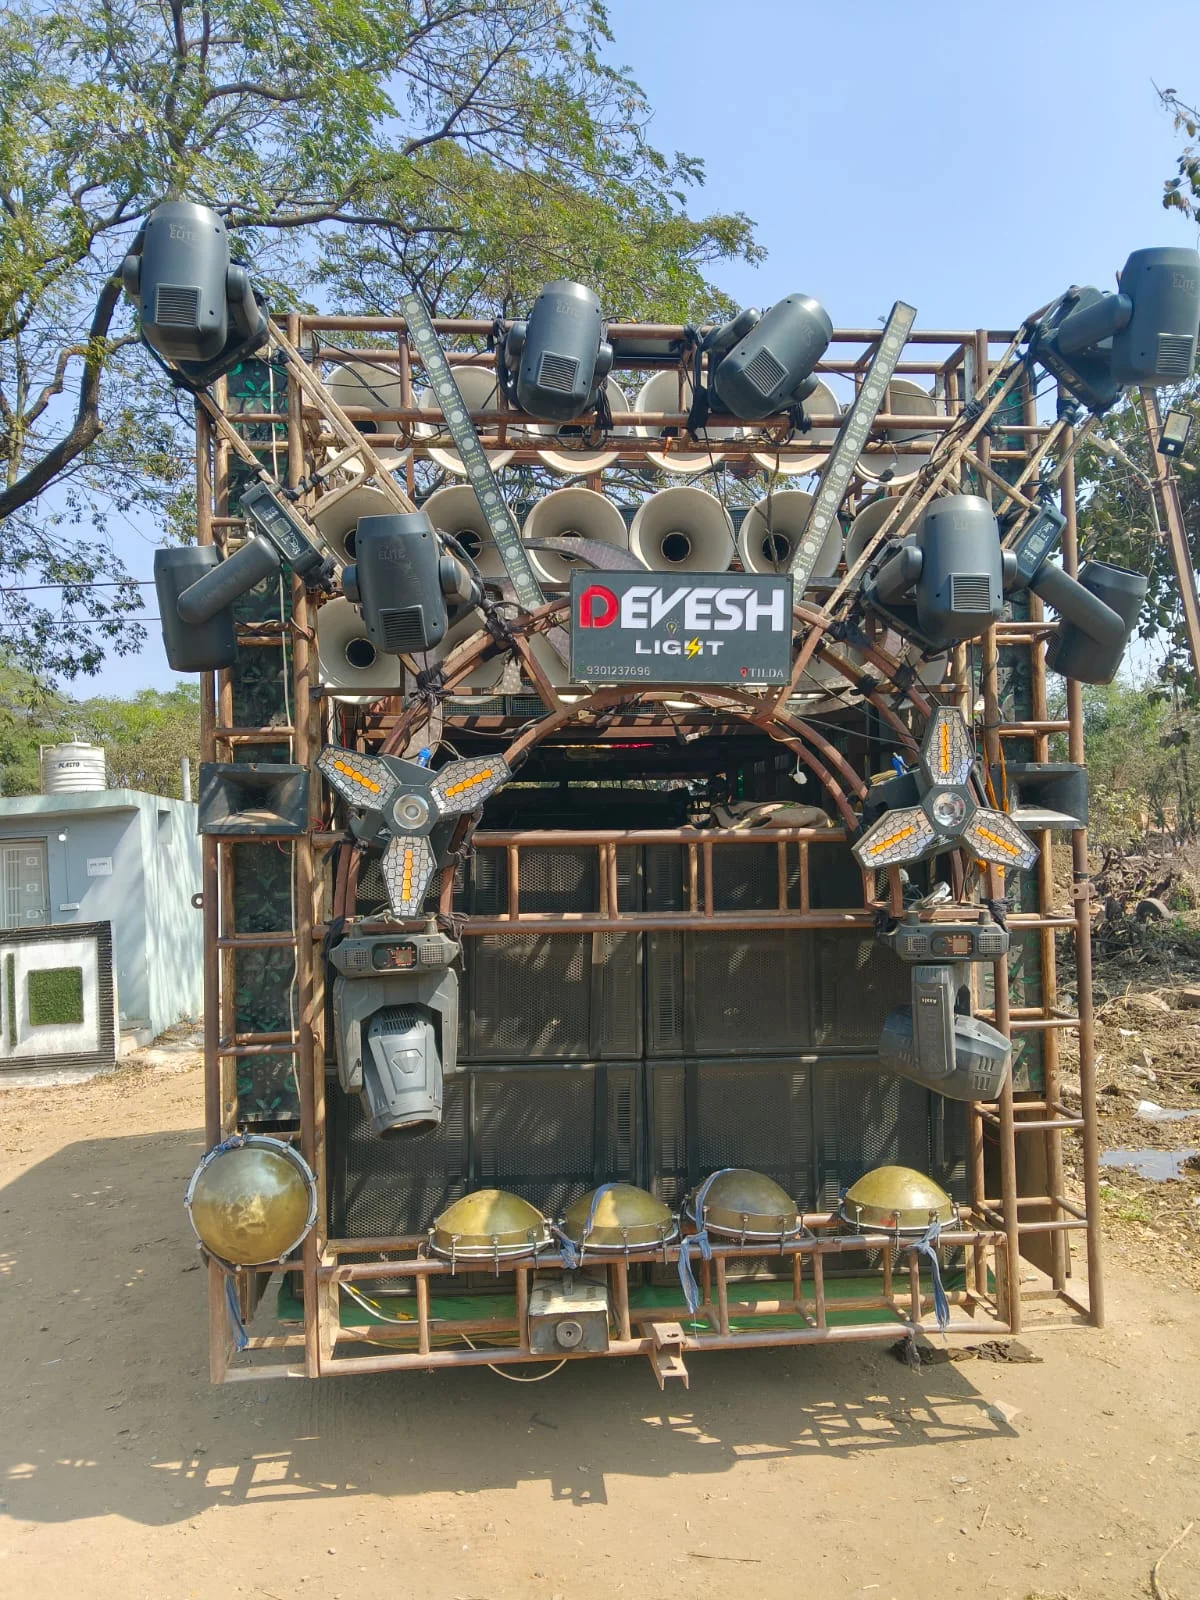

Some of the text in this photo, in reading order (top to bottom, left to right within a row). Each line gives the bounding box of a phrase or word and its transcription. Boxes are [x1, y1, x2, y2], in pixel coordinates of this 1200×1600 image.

[579, 584, 785, 632] DEVESH
[635, 639, 725, 656] LIGHT
[586, 665, 650, 676] 9301237696
[749, 667, 784, 678] TILDA
